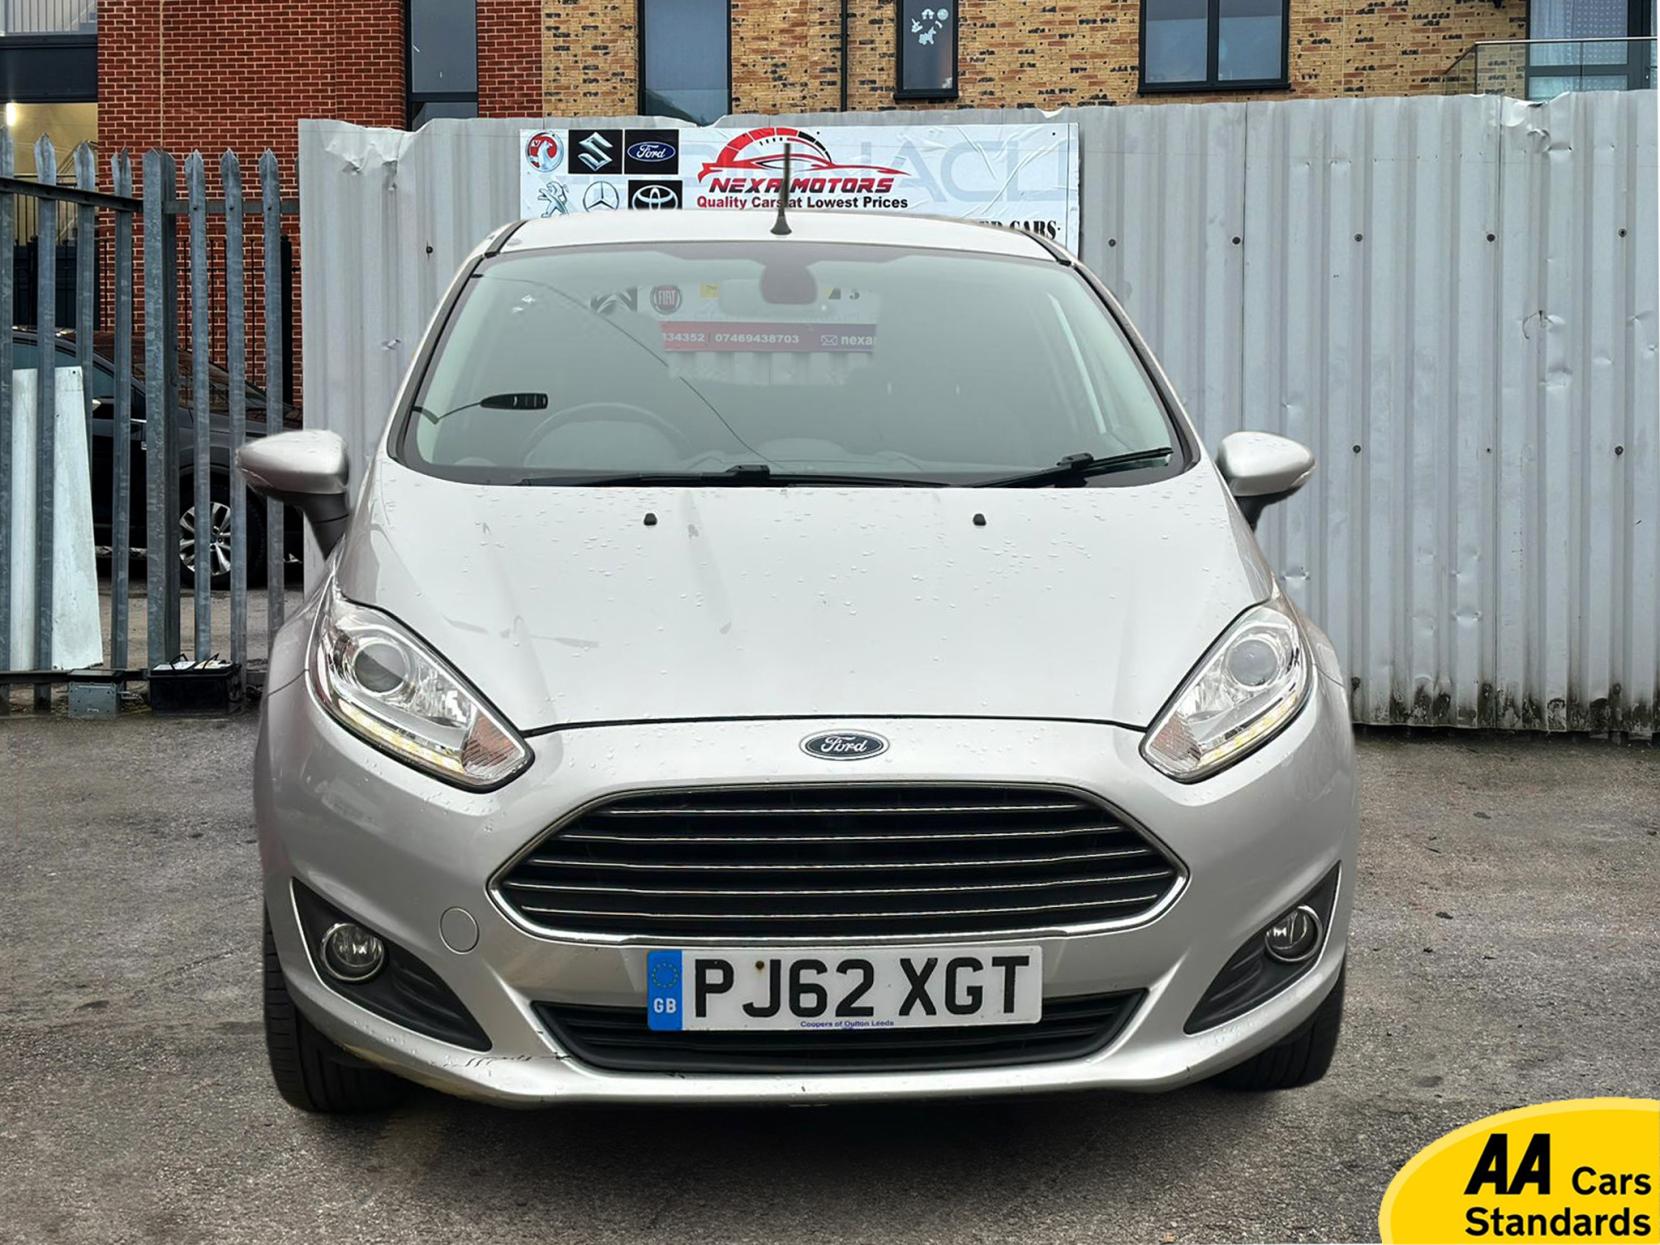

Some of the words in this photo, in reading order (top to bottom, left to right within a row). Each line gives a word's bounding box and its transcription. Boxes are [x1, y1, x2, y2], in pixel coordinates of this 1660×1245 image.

[636, 144, 667, 159] Ford
[709, 178, 783, 193] NEXA
[789, 178, 895, 193] MOTORS
[697, 196, 747, 209] Quality
[752, 196, 782, 208] Cars
[787, 197, 803, 208] at
[806, 196, 859, 208] Lowest
[862, 196, 909, 208] Prices
[840, 335, 876, 346] nexa
[820, 735, 868, 753] Ford
[694, 957, 875, 1018] PJ62
[898, 955, 1031, 1016] XGT
[652, 998, 677, 1014] GB
[800, 1020, 833, 1029] Coopers
[834, 1020, 843, 1028] of
